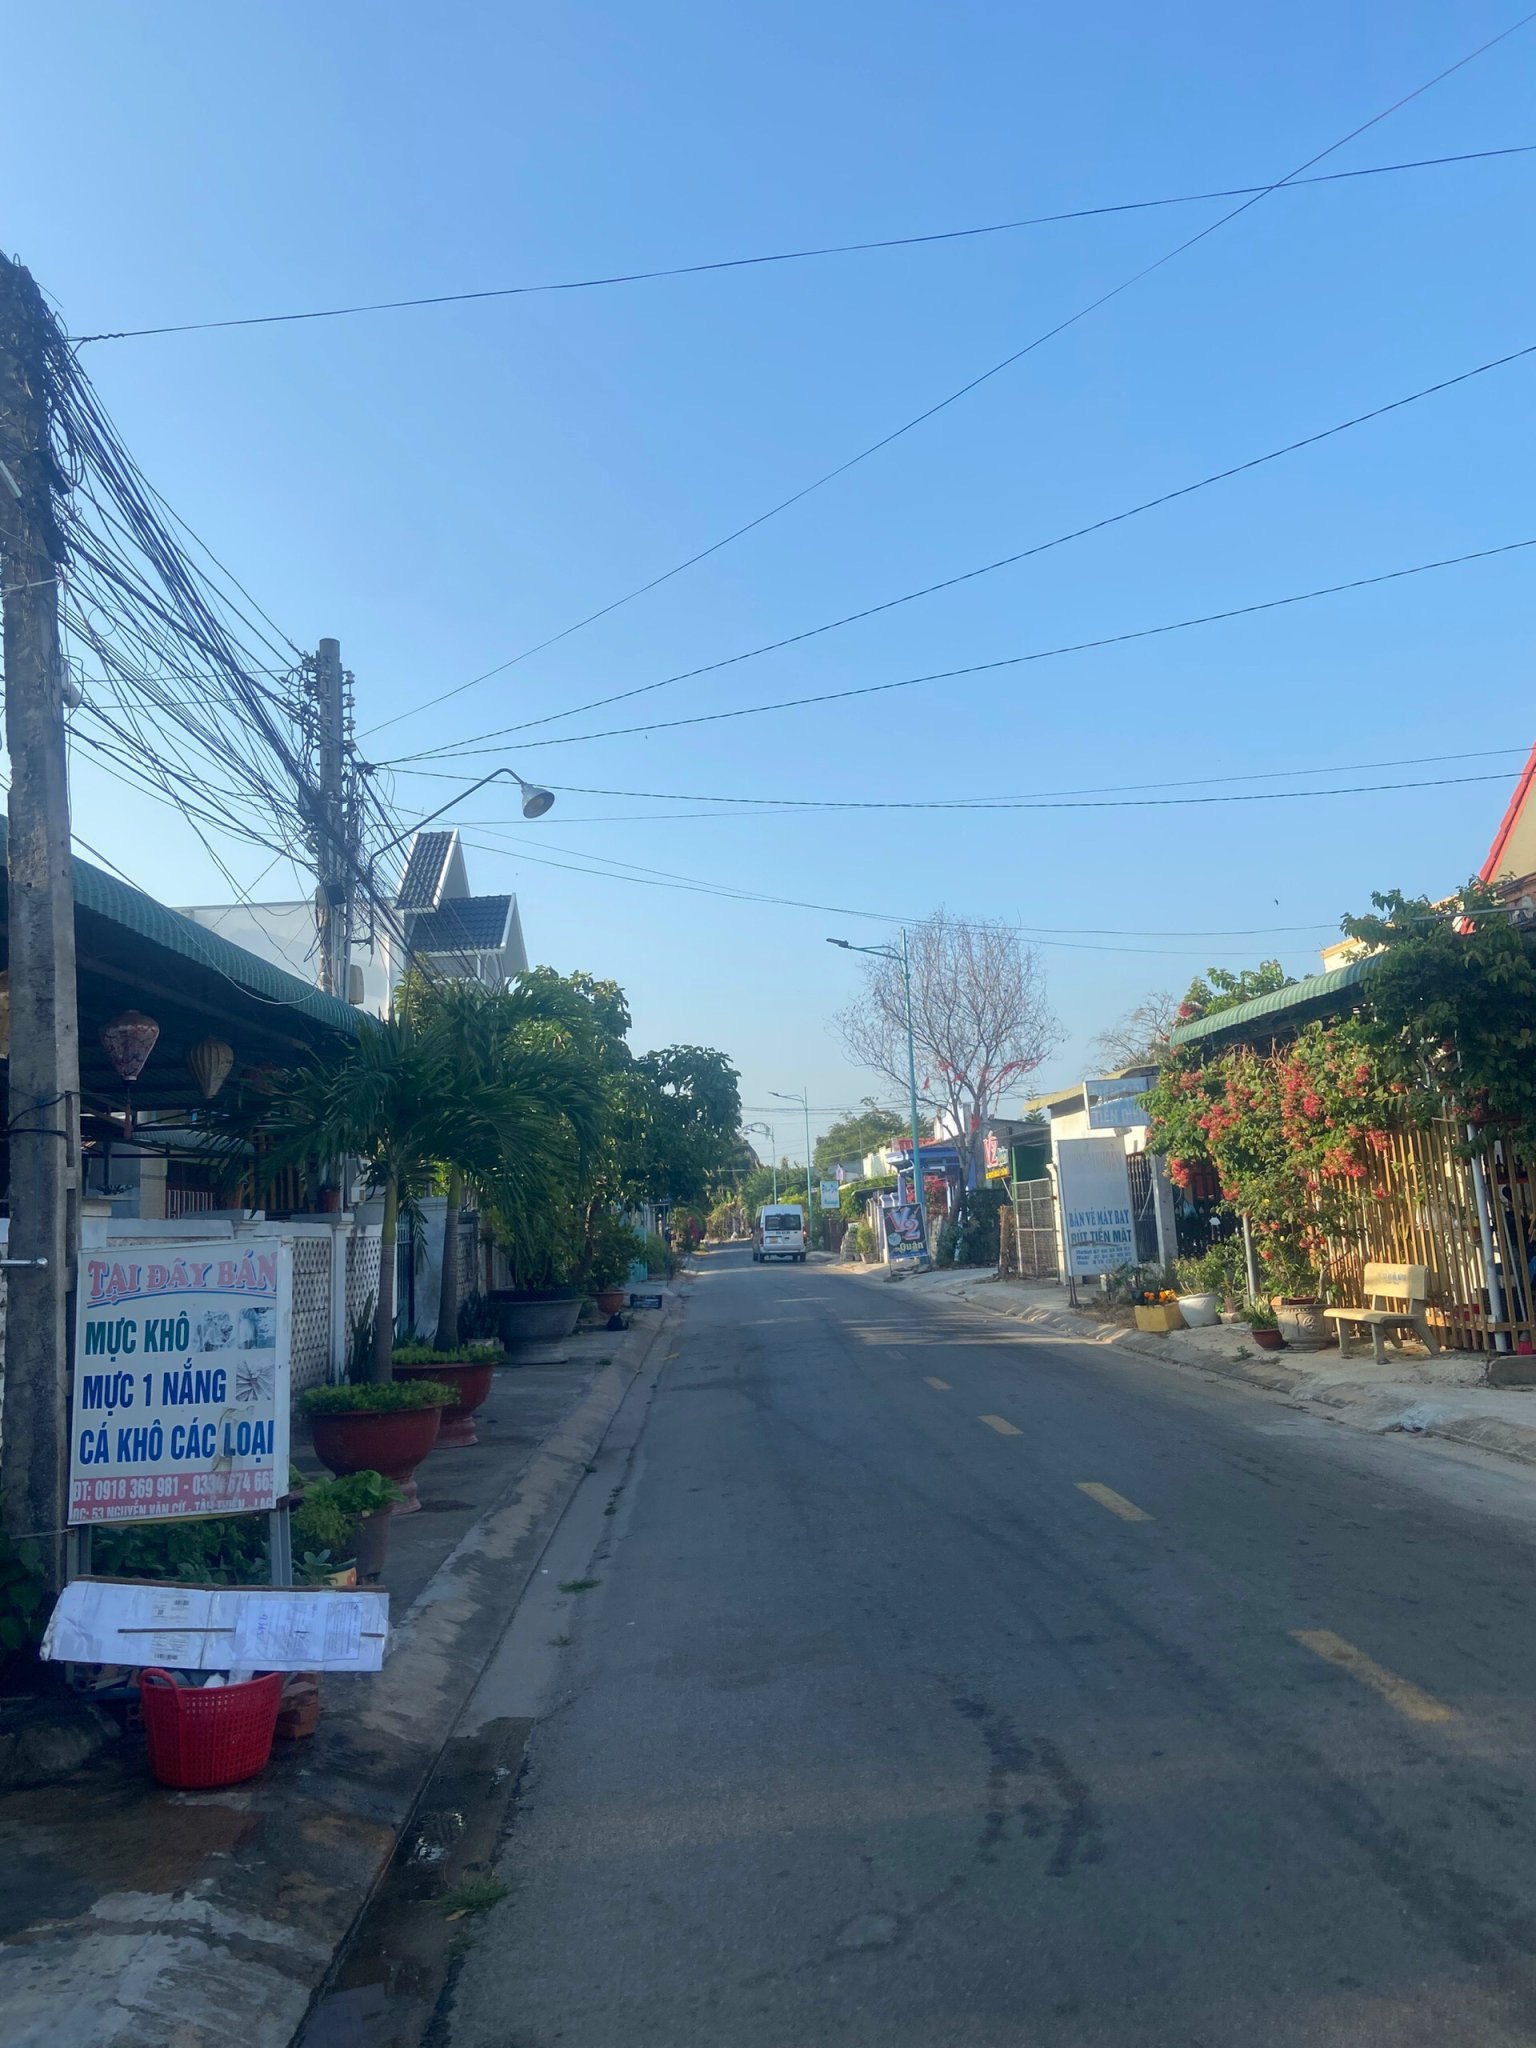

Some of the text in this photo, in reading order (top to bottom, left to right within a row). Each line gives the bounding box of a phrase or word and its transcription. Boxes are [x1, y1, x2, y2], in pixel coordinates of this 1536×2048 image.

[1114, 1208, 1129, 1225] BAY
[147, 1256, 212, 1290] ĐÂY
[217, 1248, 277, 1292] BÁN
[85, 1310, 190, 1362] MỰC KHÔ
[82, 1357, 227, 1416] MỰC 1 NẮNG
[79, 1417, 274, 1465] CÁ KHÔ CÁC LOẠI
[95, 1478, 126, 1501] 0918
[130, 1477, 153, 1499] 369
[157, 1476, 178, 1498] 981
